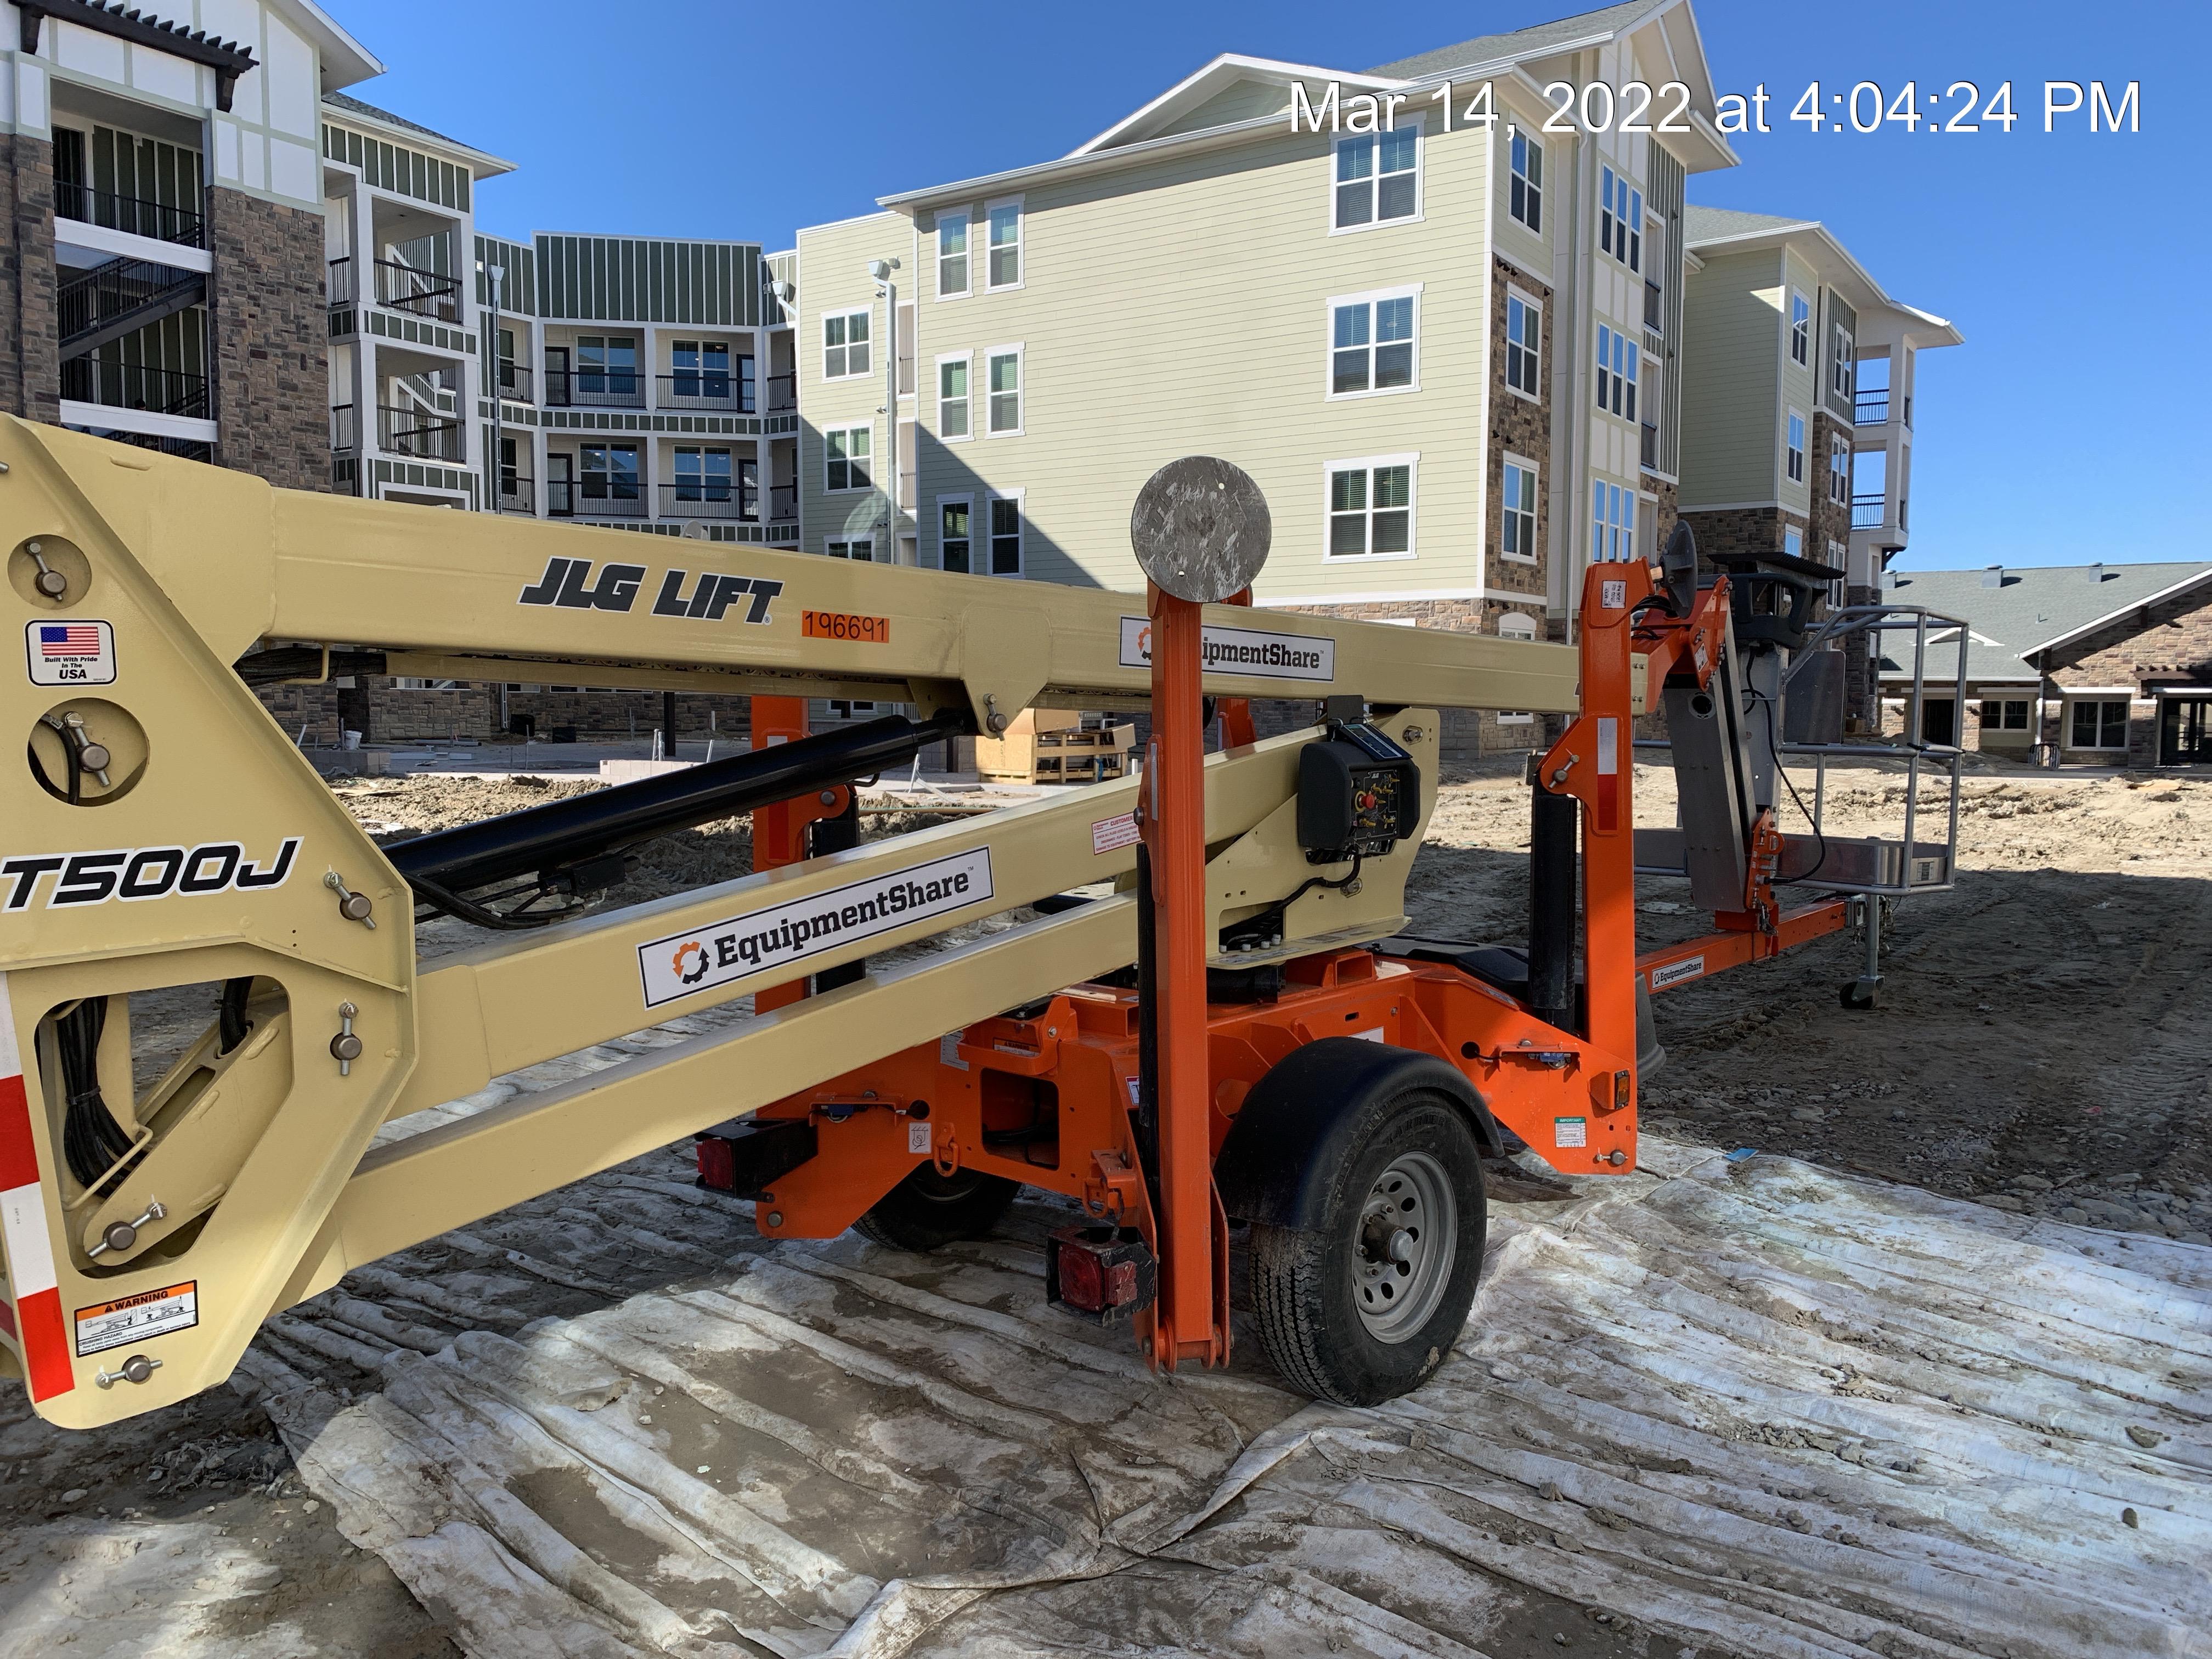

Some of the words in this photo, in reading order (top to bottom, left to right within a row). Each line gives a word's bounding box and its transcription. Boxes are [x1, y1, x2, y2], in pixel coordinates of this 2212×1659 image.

[518, 556, 647, 612] JLG
[651, 569, 785, 623] LIFT
[805, 611, 887, 641] 196691
[1201, 636, 1320, 668] ipmentShare
[59, 669, 87, 679] USA
[1110, 815, 1133, 826] CUSTOMER
[2, 840, 299, 909] T500J
[714, 870, 970, 967] EquipmentShare
[1660, 962, 1702, 982] EquipmentShare
[115, 1290, 168, 1310] WARNING
[79, 1337, 103, 1346] CRUSHING
